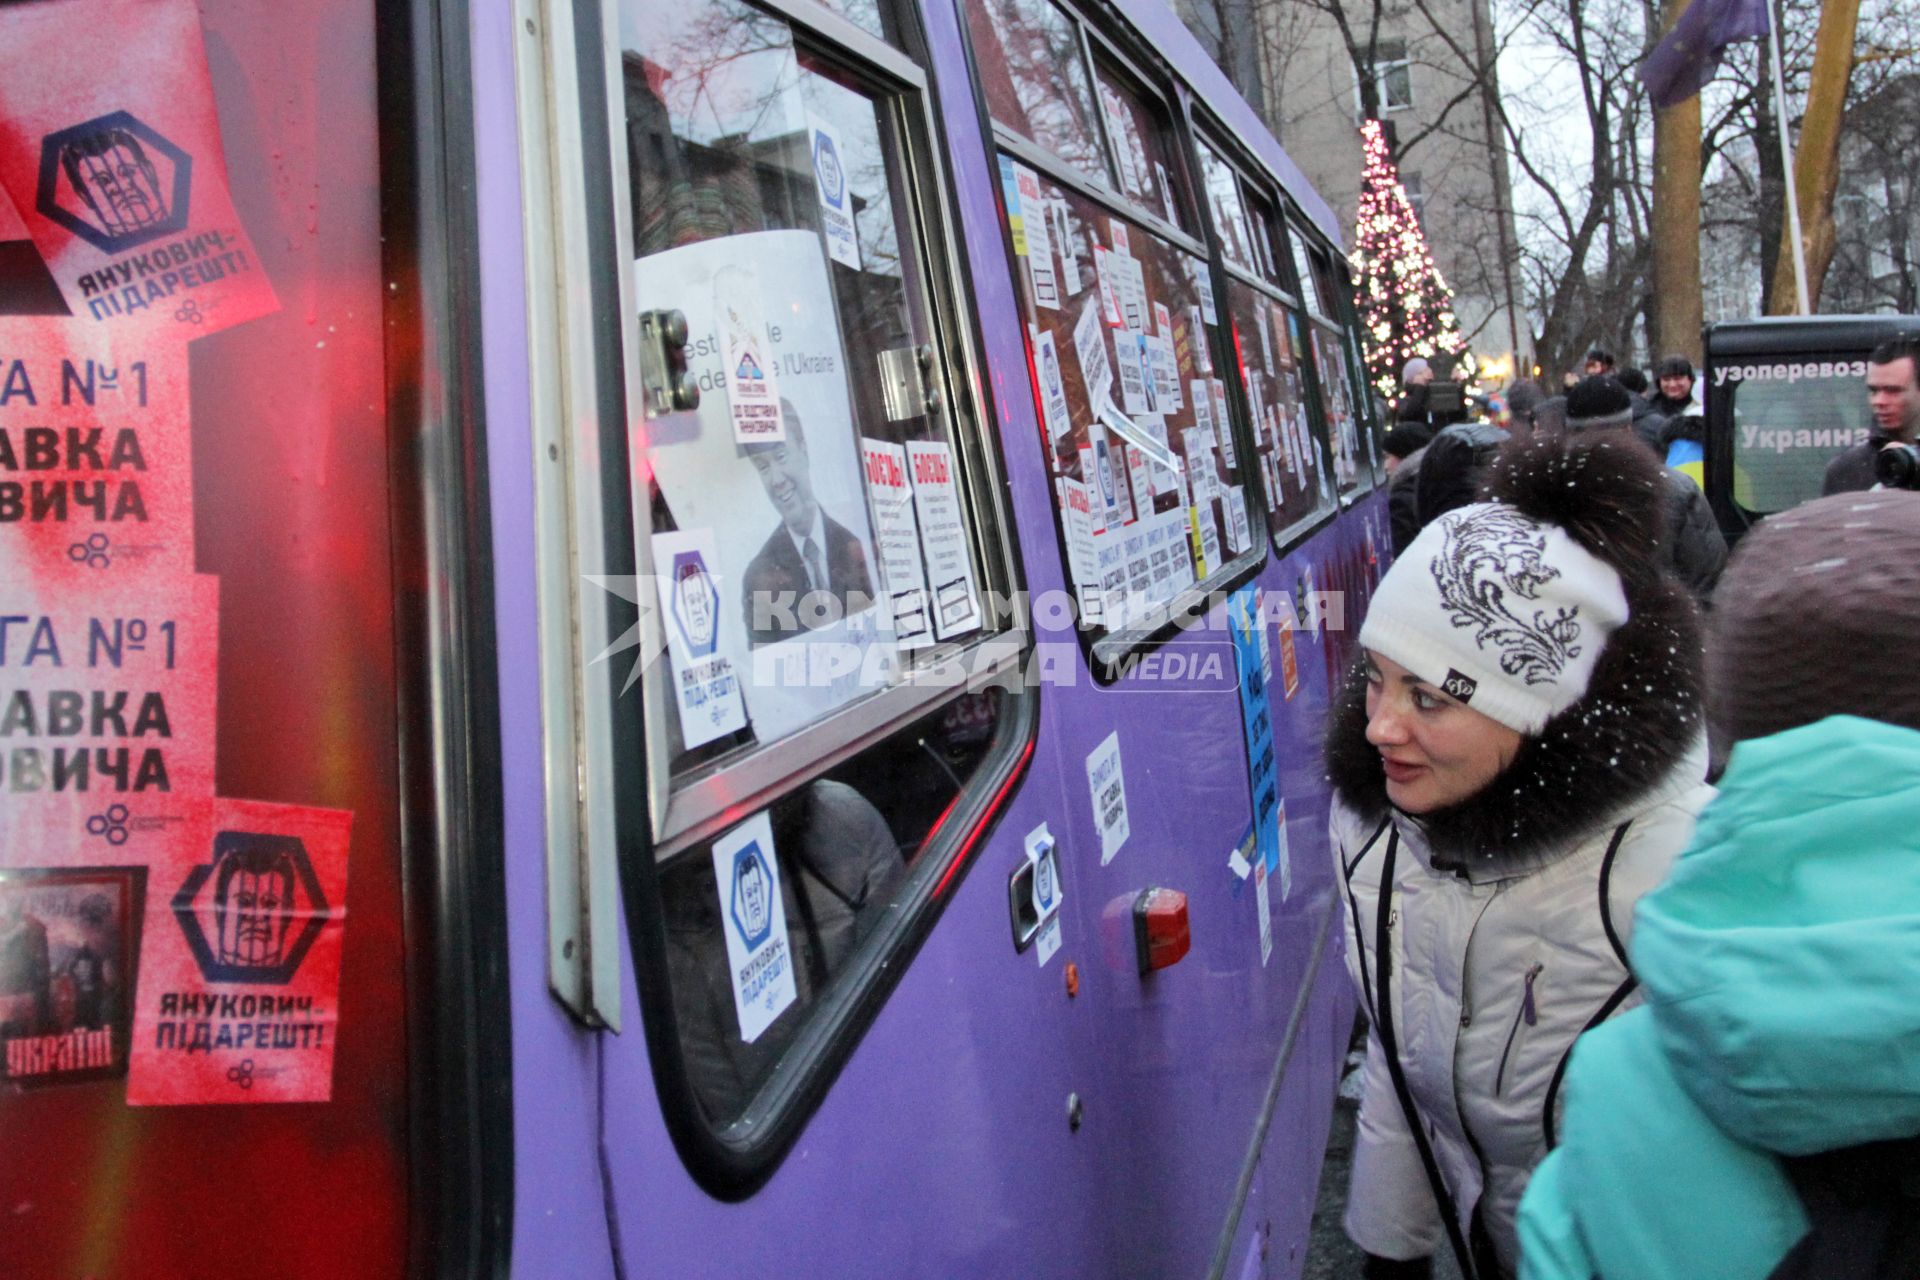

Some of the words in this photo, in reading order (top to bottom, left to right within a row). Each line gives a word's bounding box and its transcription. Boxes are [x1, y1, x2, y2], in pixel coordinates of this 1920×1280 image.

[77, 229, 237, 298] ЯНУКОВИЧ-
[88, 249, 250, 322] ПІДАРЕШТ!
[0, 747, 171, 793] ВИЧА
[160, 992, 325, 1020] ЯНУКОВИЧ-
[156, 1021, 323, 1055] ПІДАРЕШТ!
